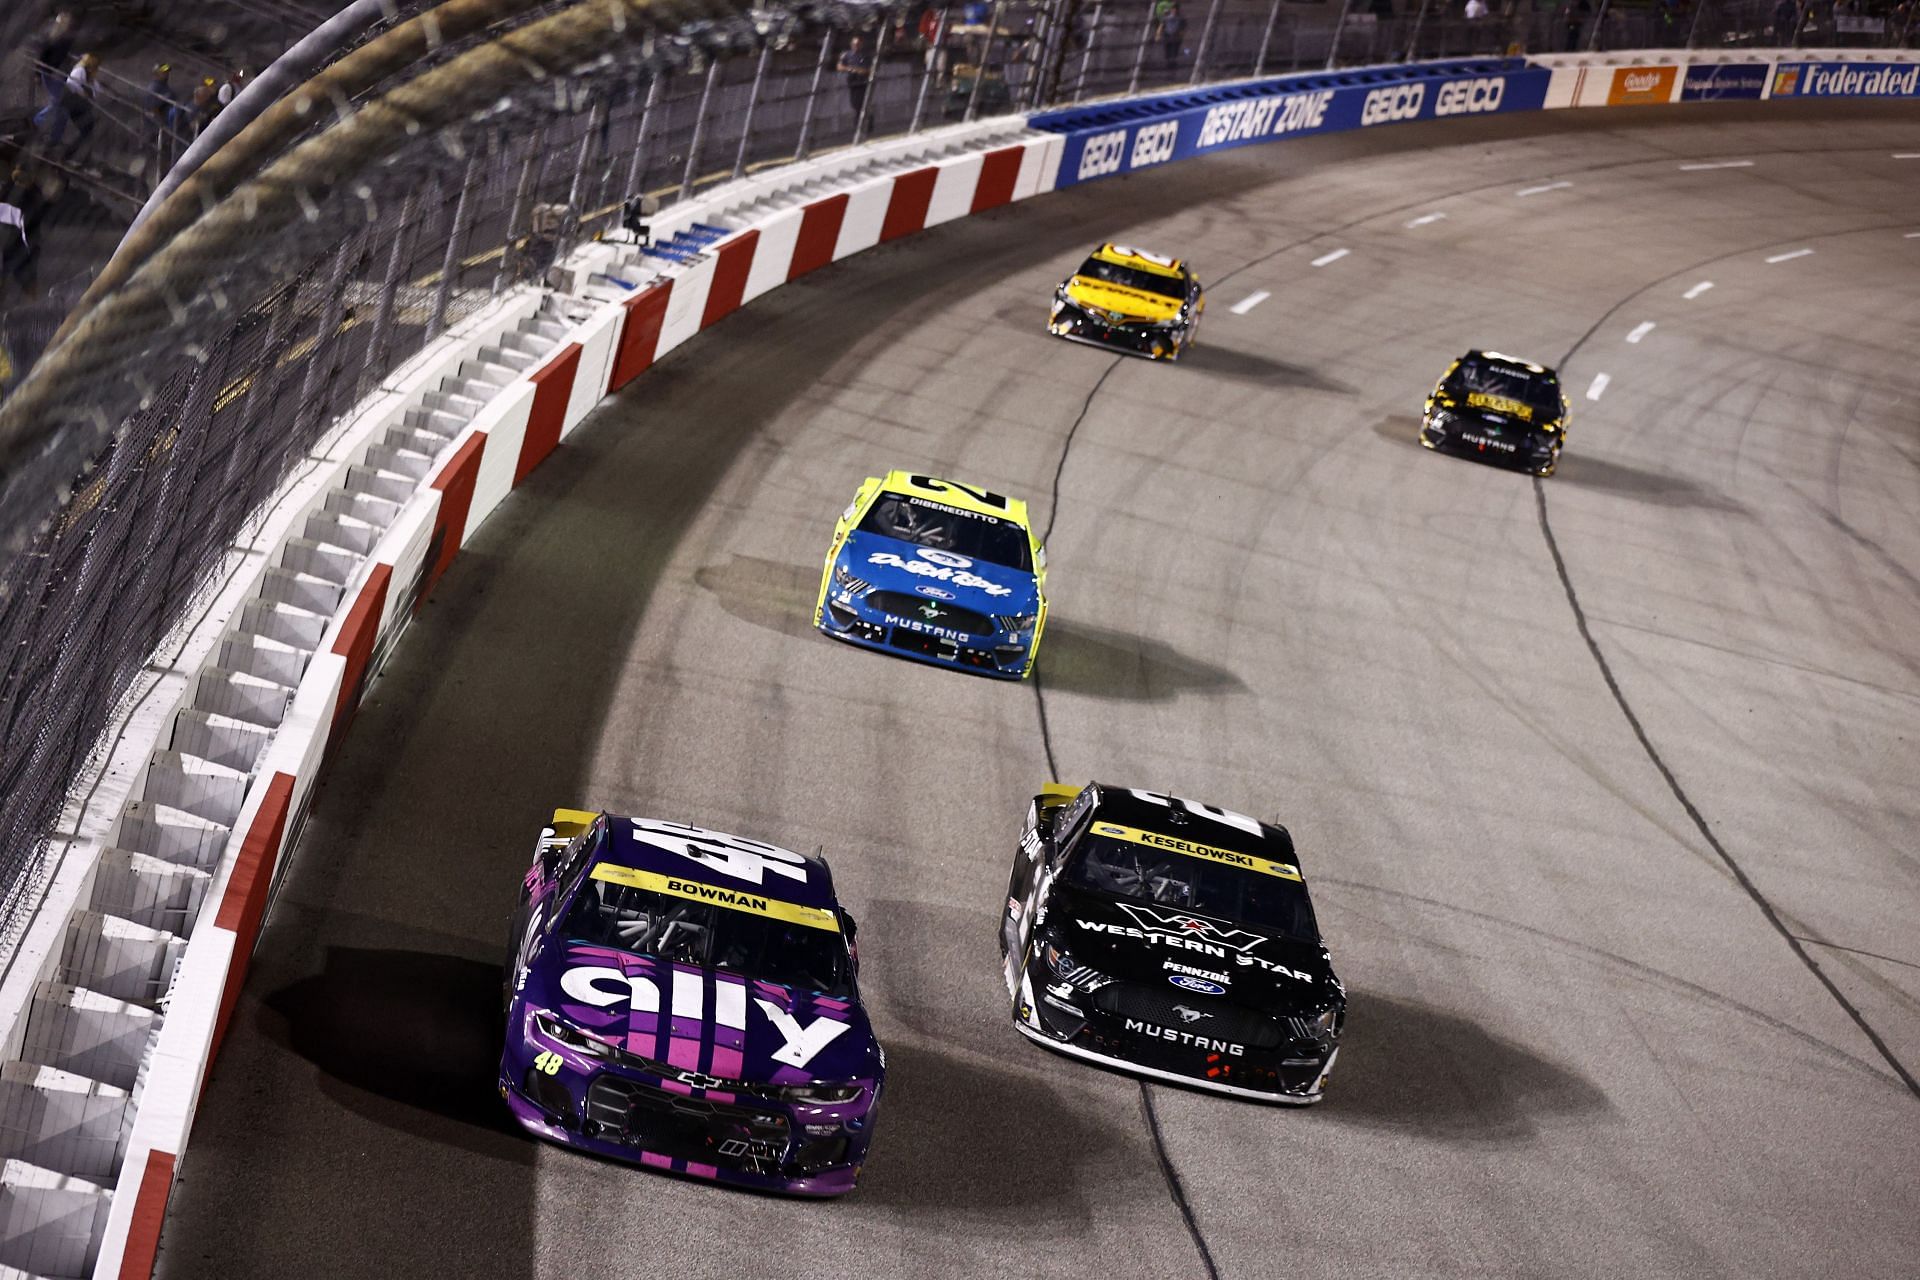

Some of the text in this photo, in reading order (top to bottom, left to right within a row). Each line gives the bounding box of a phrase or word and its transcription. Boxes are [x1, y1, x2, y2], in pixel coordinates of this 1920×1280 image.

[1802, 64, 1920, 95] Federated
[1361, 77, 1505, 126] GEICO GEICO
[1196, 90, 1335, 148] RESTART ZONE
[1078, 120, 1179, 180] GEICO GEICO
[909, 497, 999, 524] DIBENEDETTO
[885, 614, 969, 642] MUSTANG
[1141, 833, 1254, 866] KESELOWSKI
[667, 880, 767, 911] BOWMAN
[1076, 919, 1313, 983] WESTERN STAR
[1163, 960, 1232, 985] PENNZOIL
[1175, 977, 1218, 992] Ford
[560, 966, 851, 1069] ally
[1125, 1018, 1245, 1057] MUSTANG
[533, 1050, 564, 1076] 48
